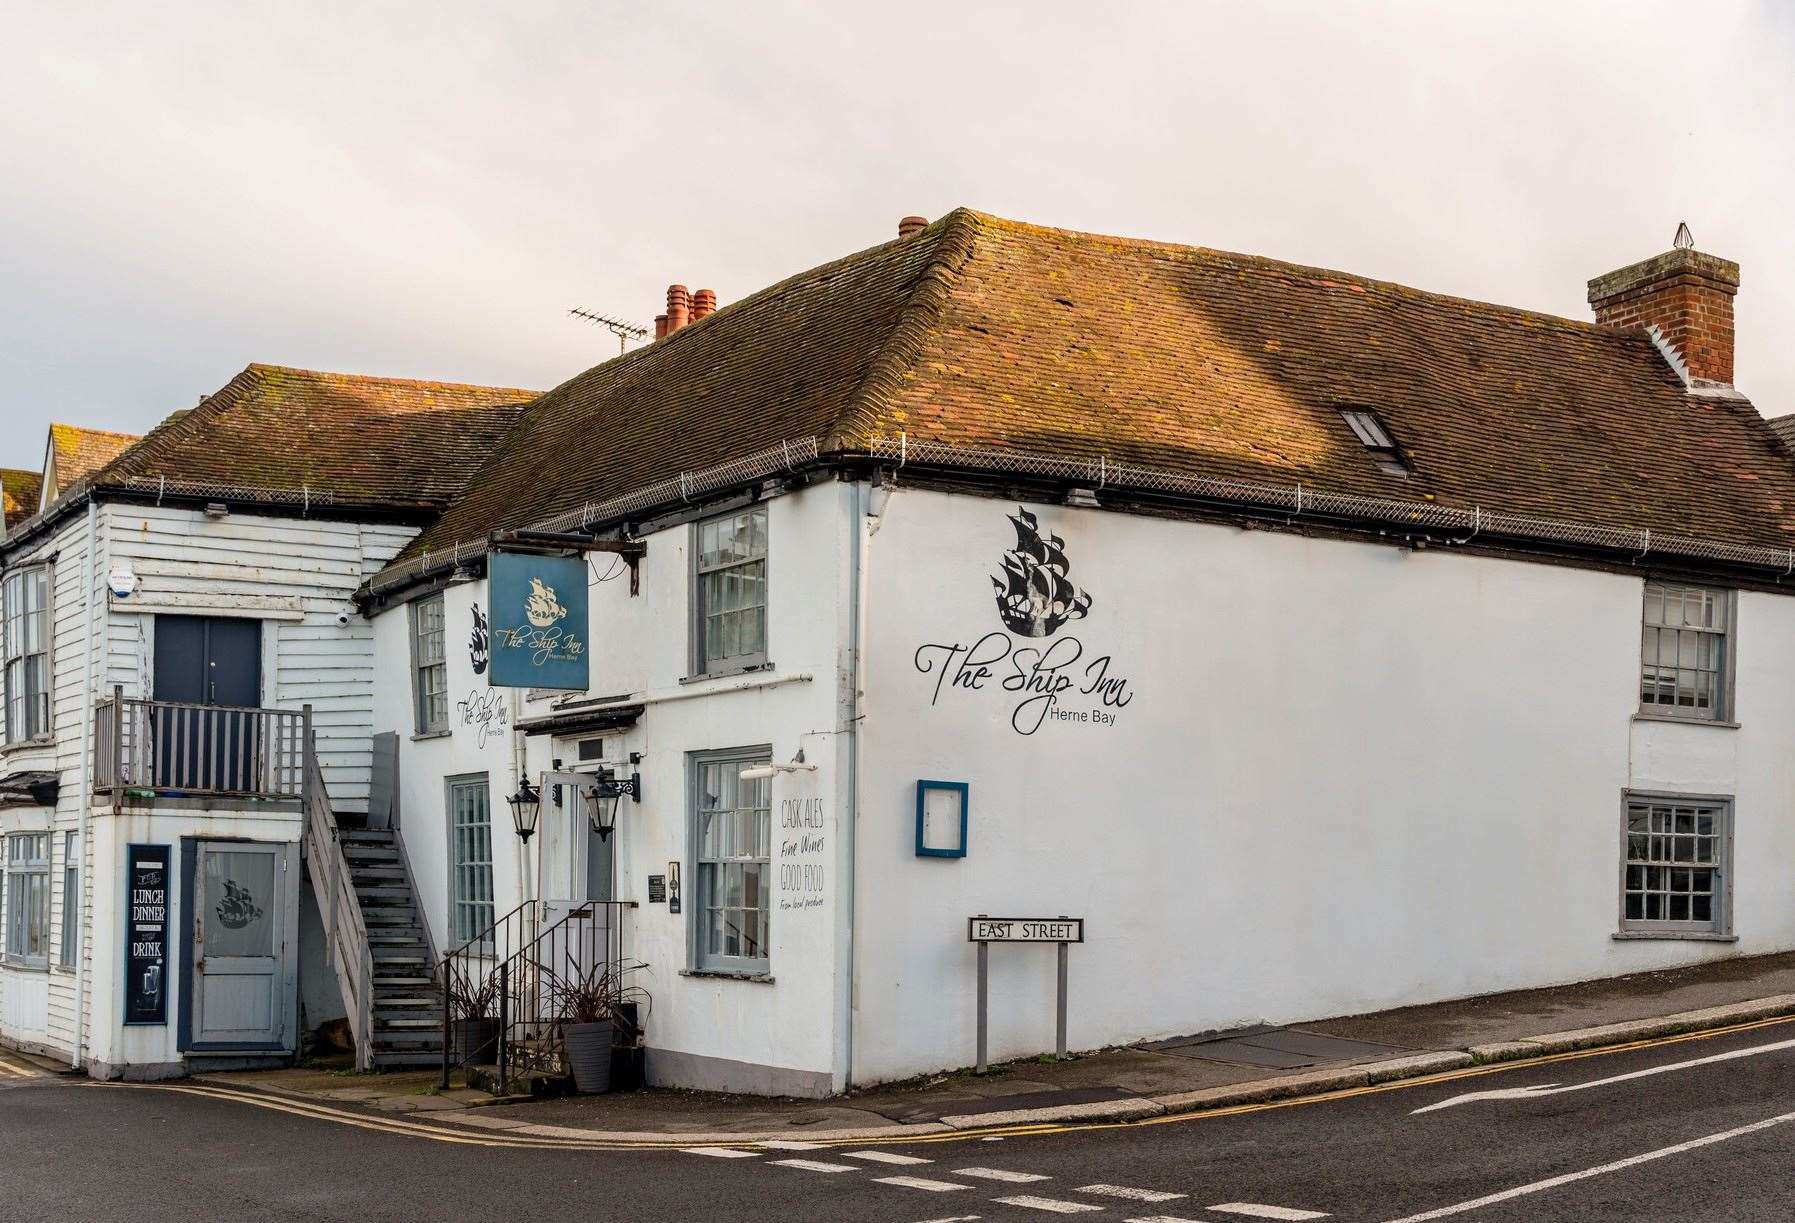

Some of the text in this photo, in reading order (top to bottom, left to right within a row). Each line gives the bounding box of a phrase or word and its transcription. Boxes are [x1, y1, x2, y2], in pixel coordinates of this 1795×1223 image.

[495, 625, 585, 666] The Ship Inn
[915, 632, 1133, 736] The Ship Inn
[457, 690, 478, 728] The
[476, 687, 495, 750] Ship
[1050, 707, 1116, 727] Herne Bay
[781, 798, 823, 828] CASK ALES
[781, 833, 824, 857] Fine Wines
[781, 864, 823, 891] GOOD FOOD
[133, 890, 164, 904] LUNCH
[133, 907, 165, 921] DINNER
[979, 923, 1073, 938] EAST STREET
[133, 943, 161, 957] DRINK
